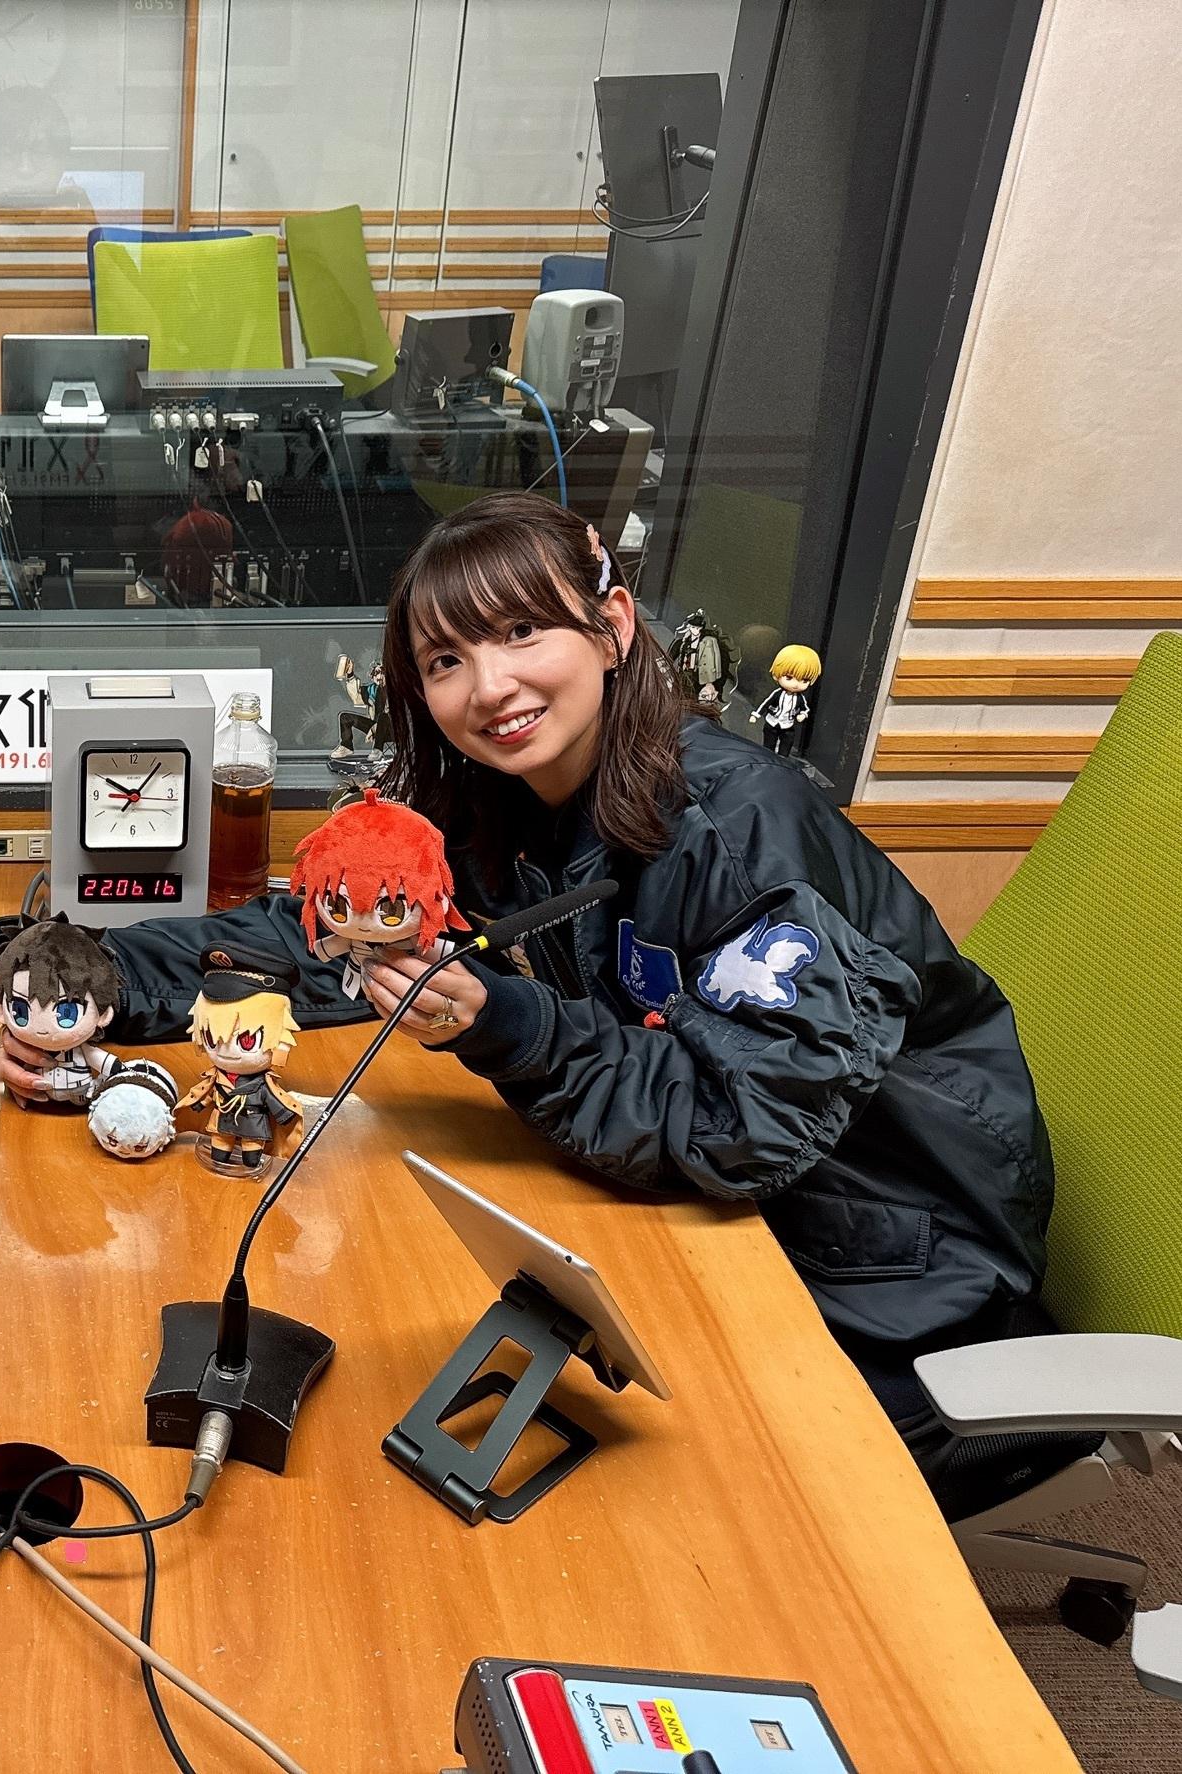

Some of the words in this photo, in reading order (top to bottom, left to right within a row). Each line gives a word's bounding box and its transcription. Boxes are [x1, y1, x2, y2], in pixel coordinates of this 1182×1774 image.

[129, 753, 138, 765] 12
[93, 789, 100, 801] 9
[166, 787, 174, 799] 3
[129, 824, 136, 836] 6
[531, 898, 600, 936] SENNHEISER
[660, 1705, 672, 1714] 2
[584, 1693, 614, 1752] TAMURA
[648, 1715, 668, 1745] ANN
[664, 1717, 687, 1747] ANN
